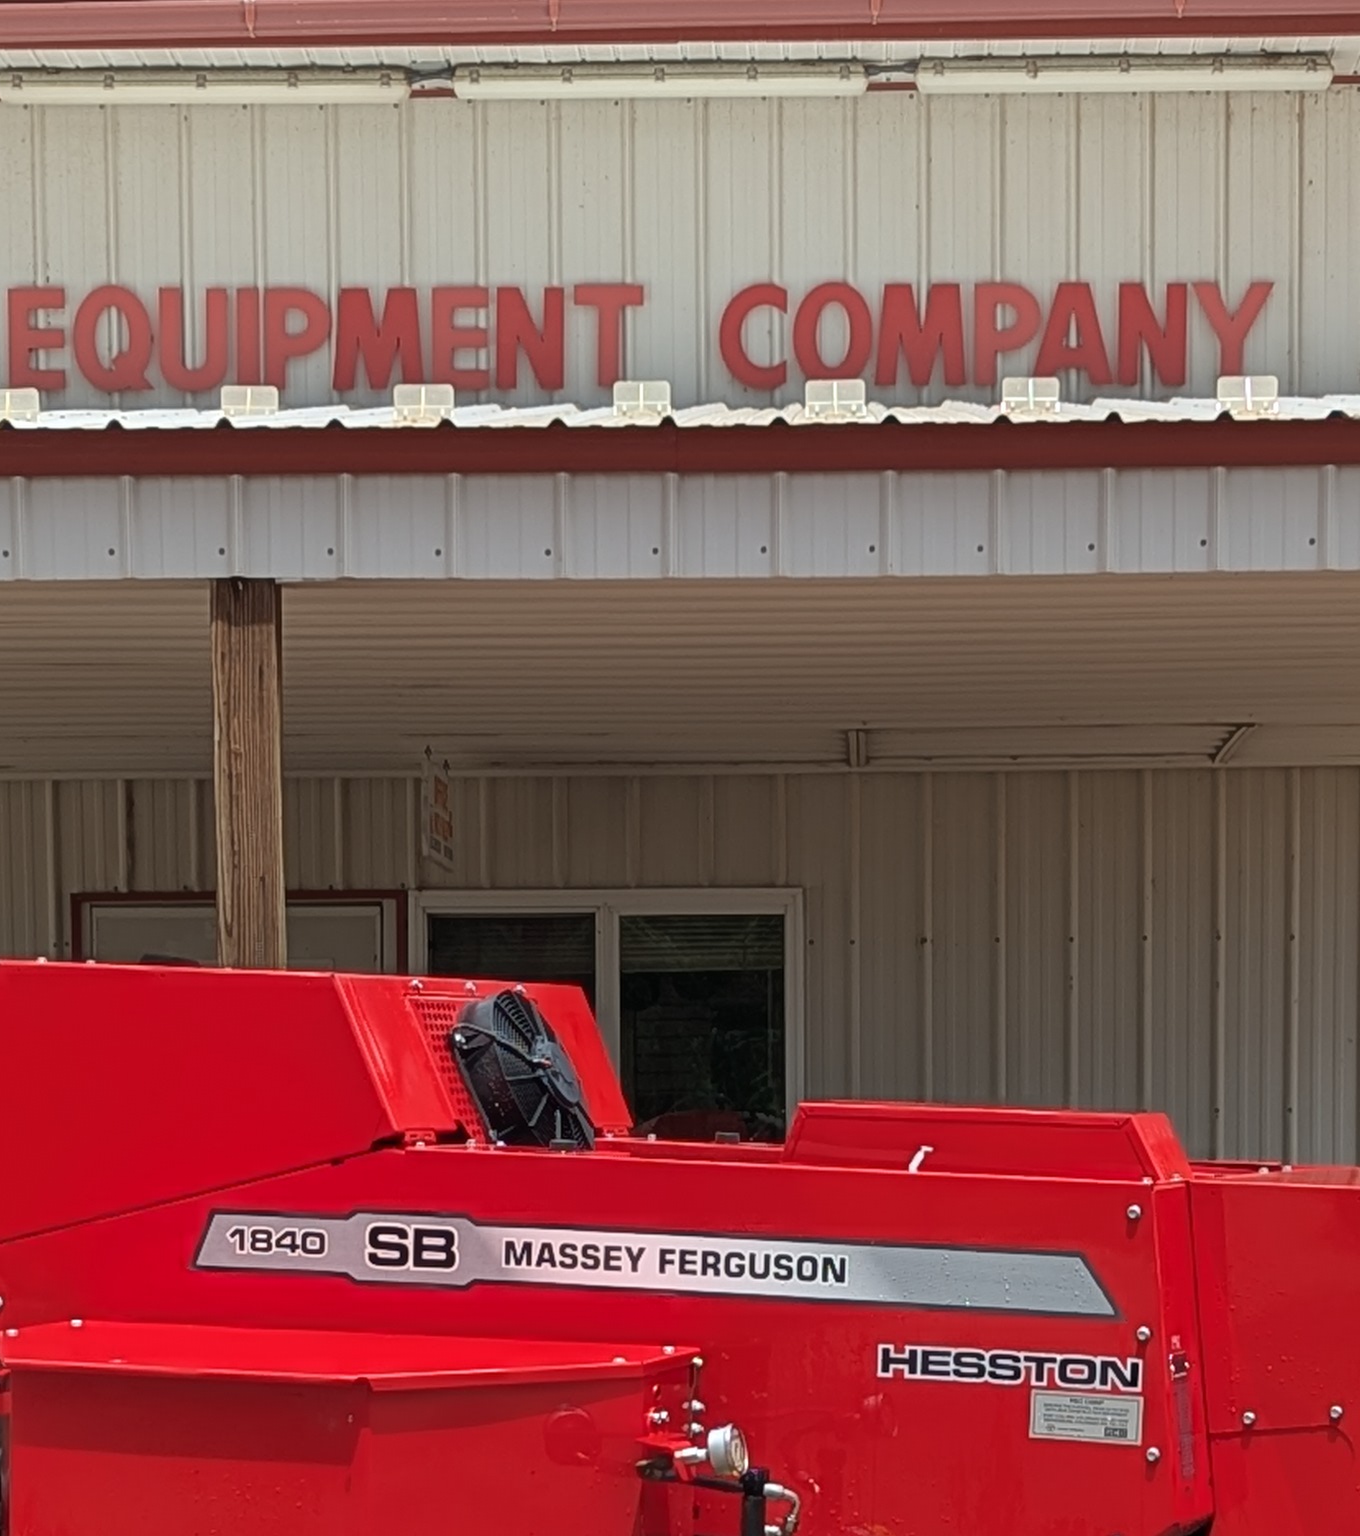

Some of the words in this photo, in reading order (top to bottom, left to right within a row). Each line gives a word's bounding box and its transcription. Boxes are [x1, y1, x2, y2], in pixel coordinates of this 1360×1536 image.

[6, 284, 645, 393] EQUIPMENT
[719, 282, 1275, 390] COMPANY
[227, 1225, 328, 1256] 1840
[365, 1221, 460, 1271] SB
[503, 1238, 646, 1274] MASSEY
[658, 1247, 848, 1287] FERGUSON
[877, 1344, 1143, 1392] HESSTON
